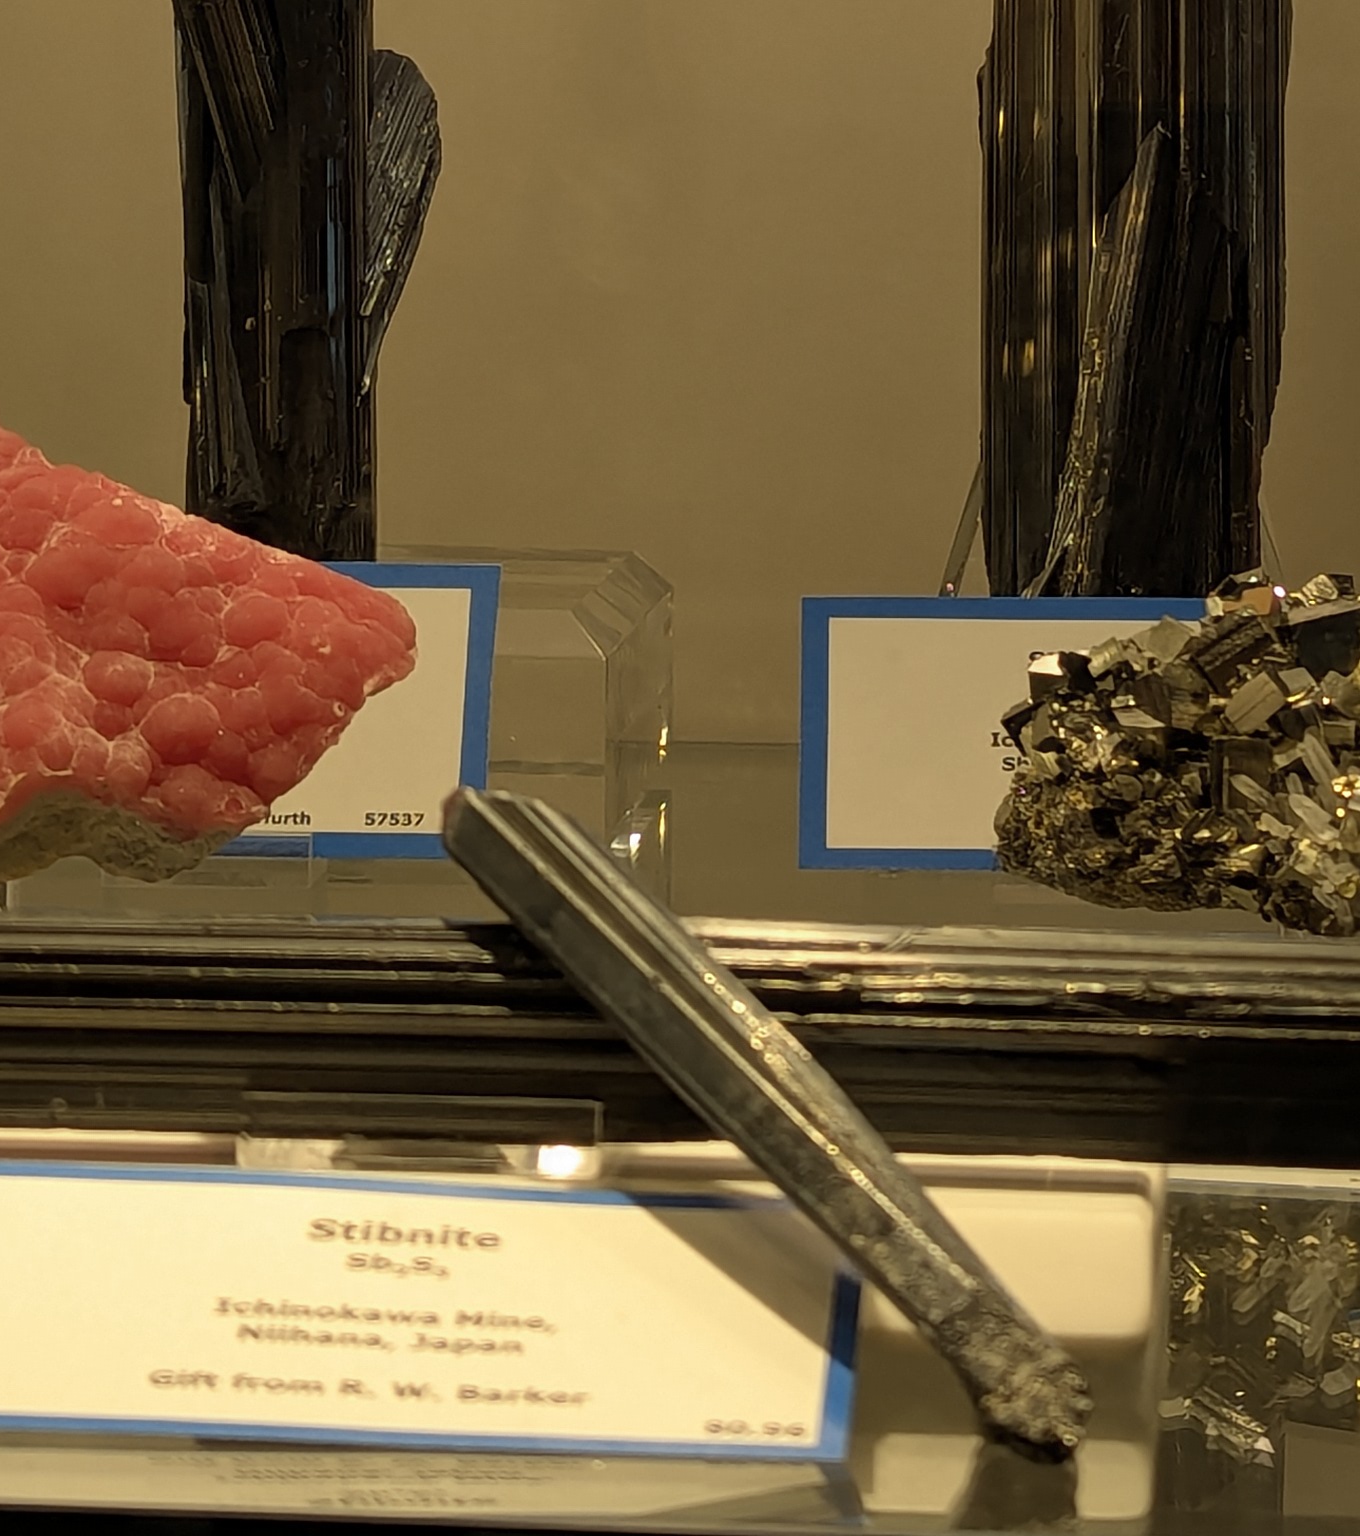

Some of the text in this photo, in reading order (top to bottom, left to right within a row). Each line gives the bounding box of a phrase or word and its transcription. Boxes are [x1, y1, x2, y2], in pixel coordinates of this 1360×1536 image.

[364, 812, 425, 826] 57537
[309, 1216, 501, 1248] Stibnite
[214, 1297, 557, 1334] Ichinokawa Mine,
[409, 1333, 525, 1357] Japan
[148, 1369, 219, 1392] Gift
[232, 1371, 325, 1396] from
[456, 1383, 588, 1408] Barker
